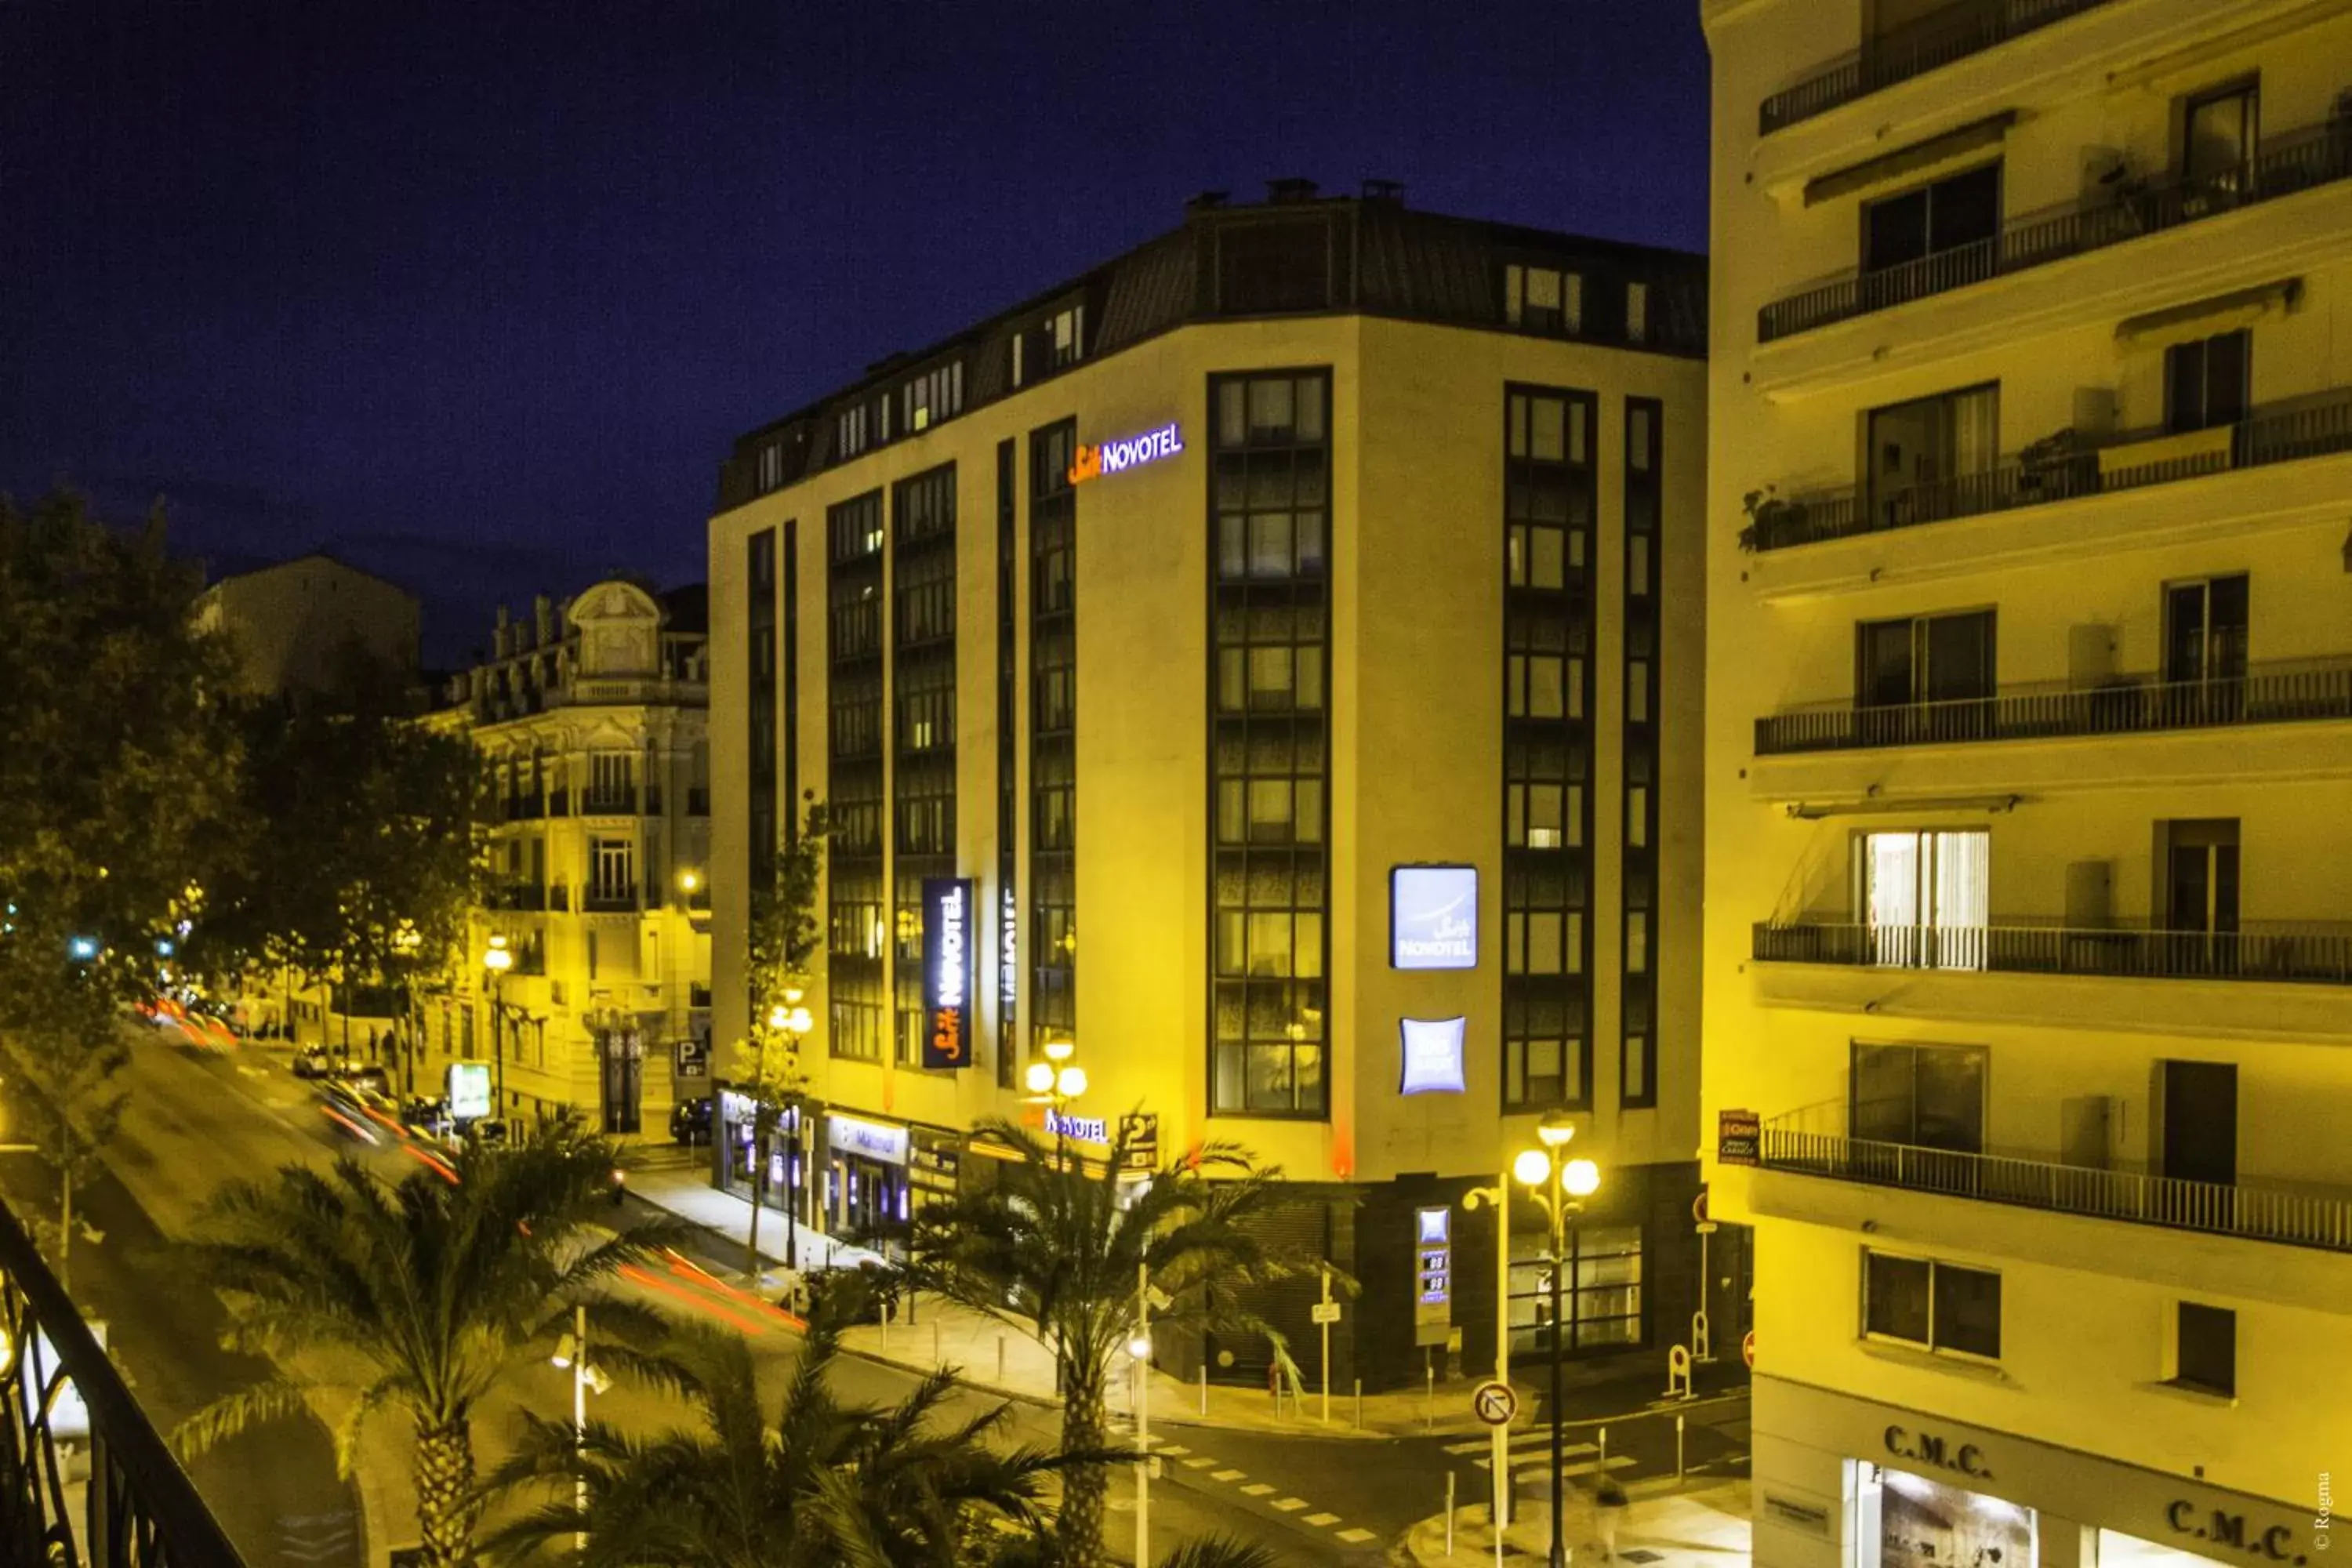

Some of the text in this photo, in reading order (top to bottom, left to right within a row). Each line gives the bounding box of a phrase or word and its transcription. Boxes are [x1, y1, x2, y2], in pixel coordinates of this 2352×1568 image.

[1102, 423, 1182, 474] NOVOTEL
[938, 886, 964, 1007] NOVOTEL
[1399, 939, 1472, 956] NOVOTEL
[680, 1043, 696, 1064] P
[1884, 1425, 1994, 1482] C.M.C.
[2166, 1500, 2308, 1566] C.M.C.
